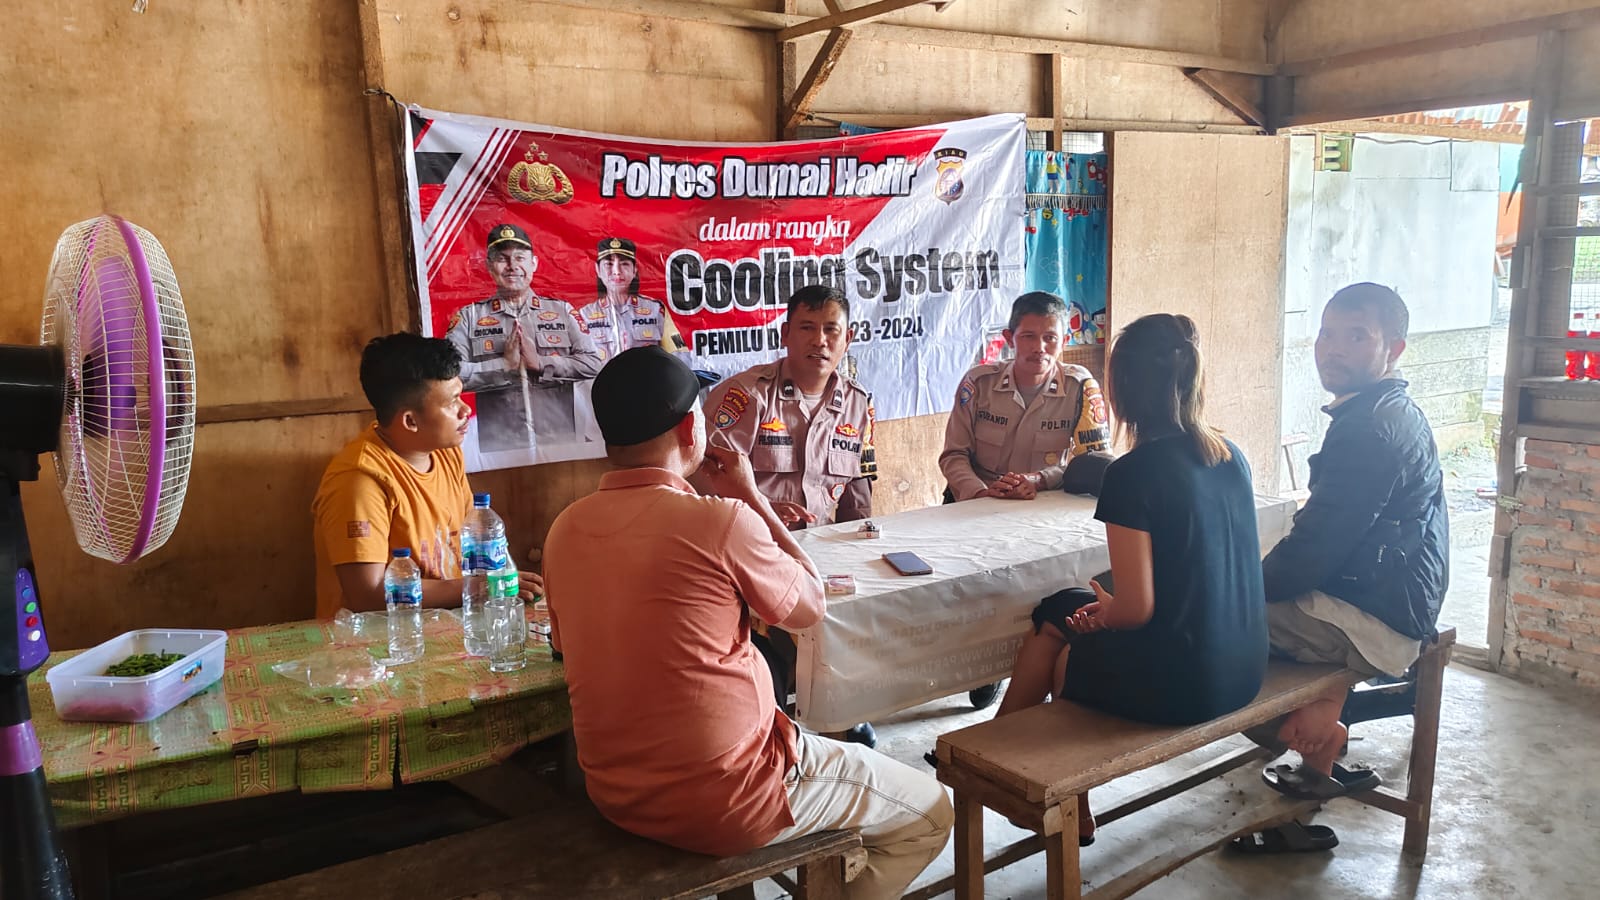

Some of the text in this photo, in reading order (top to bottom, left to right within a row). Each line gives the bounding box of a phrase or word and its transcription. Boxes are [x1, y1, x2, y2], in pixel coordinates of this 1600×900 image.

[600, 153, 917, 199] Polres Dumai Hadir
[699, 215, 850, 246] dalam rangka
[855, 247, 999, 303] System
[537, 322, 566, 331] POLRI
[695, 330, 763, 356] PEMILU
[849, 320, 872, 343] 23
[1040, 419, 1071, 431] POLRI
[832, 438, 861, 453] POLRI
